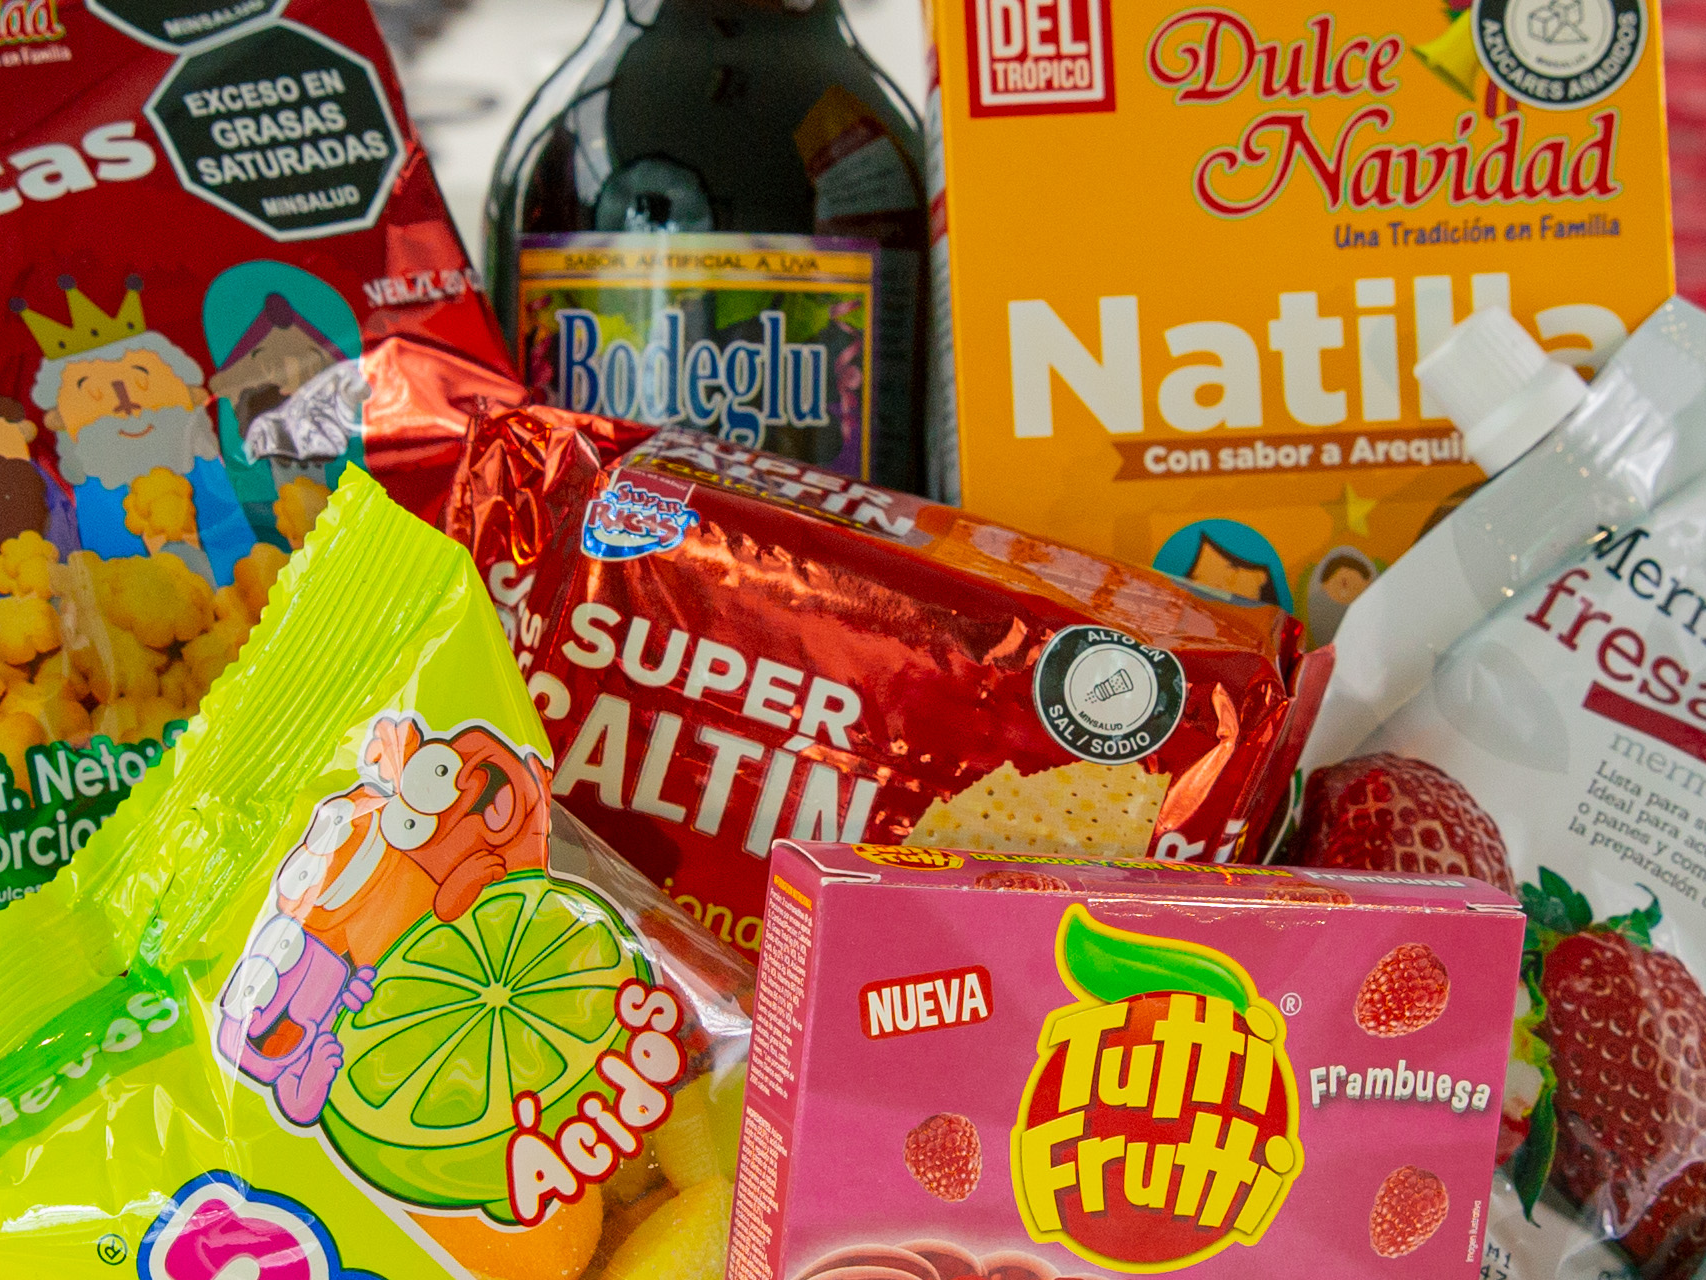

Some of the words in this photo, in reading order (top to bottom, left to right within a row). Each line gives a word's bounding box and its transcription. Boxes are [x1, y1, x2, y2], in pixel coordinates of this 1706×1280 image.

[993, 59, 1092, 93] TRÓPICO
[1146, 6, 1401, 105] Dulce
[183, 77, 299, 117] EXCESO
[307, 69, 345, 97] EN
[211, 103, 347, 150] GRASAS
[197, 131, 389, 186] SATURADAS
[1192, 107, 1622, 220] Navidad
[261, 185, 361, 218] MINSALUD
[1334, 225, 1380, 249] Una
[1387, 220, 1496, 247] Tradición
[1505, 226, 1533, 245] en
[1538, 214, 1622, 242] Familia
[779, 255, 820, 272] UVA
[556, 308, 830, 450] Bodeglu
[1143, 446, 1212, 476] Con
[1221, 438, 1312, 472] sabor
[1321, 444, 1342, 466] a
[1349, 431, 1475, 467] Arequi
[614, 483, 683, 517] SUPER
[1087, 630, 1135, 644] ALTO
[561, 602, 862, 750] SUPER
[1048, 704, 1076, 740] SAL
[1090, 730, 1151, 757] SODIO
[1078, 711, 1124, 731] MINSALUD
[1587, 779, 1634, 814] Ideal
[1635, 810, 1680, 841] para
[1595, 760, 1642, 798] Lista
[1646, 790, 1691, 822] para
[1594, 811, 1650, 845] panes
[1302, 870, 1467, 888] Frambuesa
[1568, 815, 1587, 837] la
[1589, 829, 1698, 901] preparación
[867, 974, 989, 1036] NUEVA
[1055, 994, 1277, 1120] Tutti
[506, 978, 686, 1226] Ácidos
[1310, 1059, 1491, 1113] Frambuesa
[1020, 1114, 1295, 1235] Frutti
